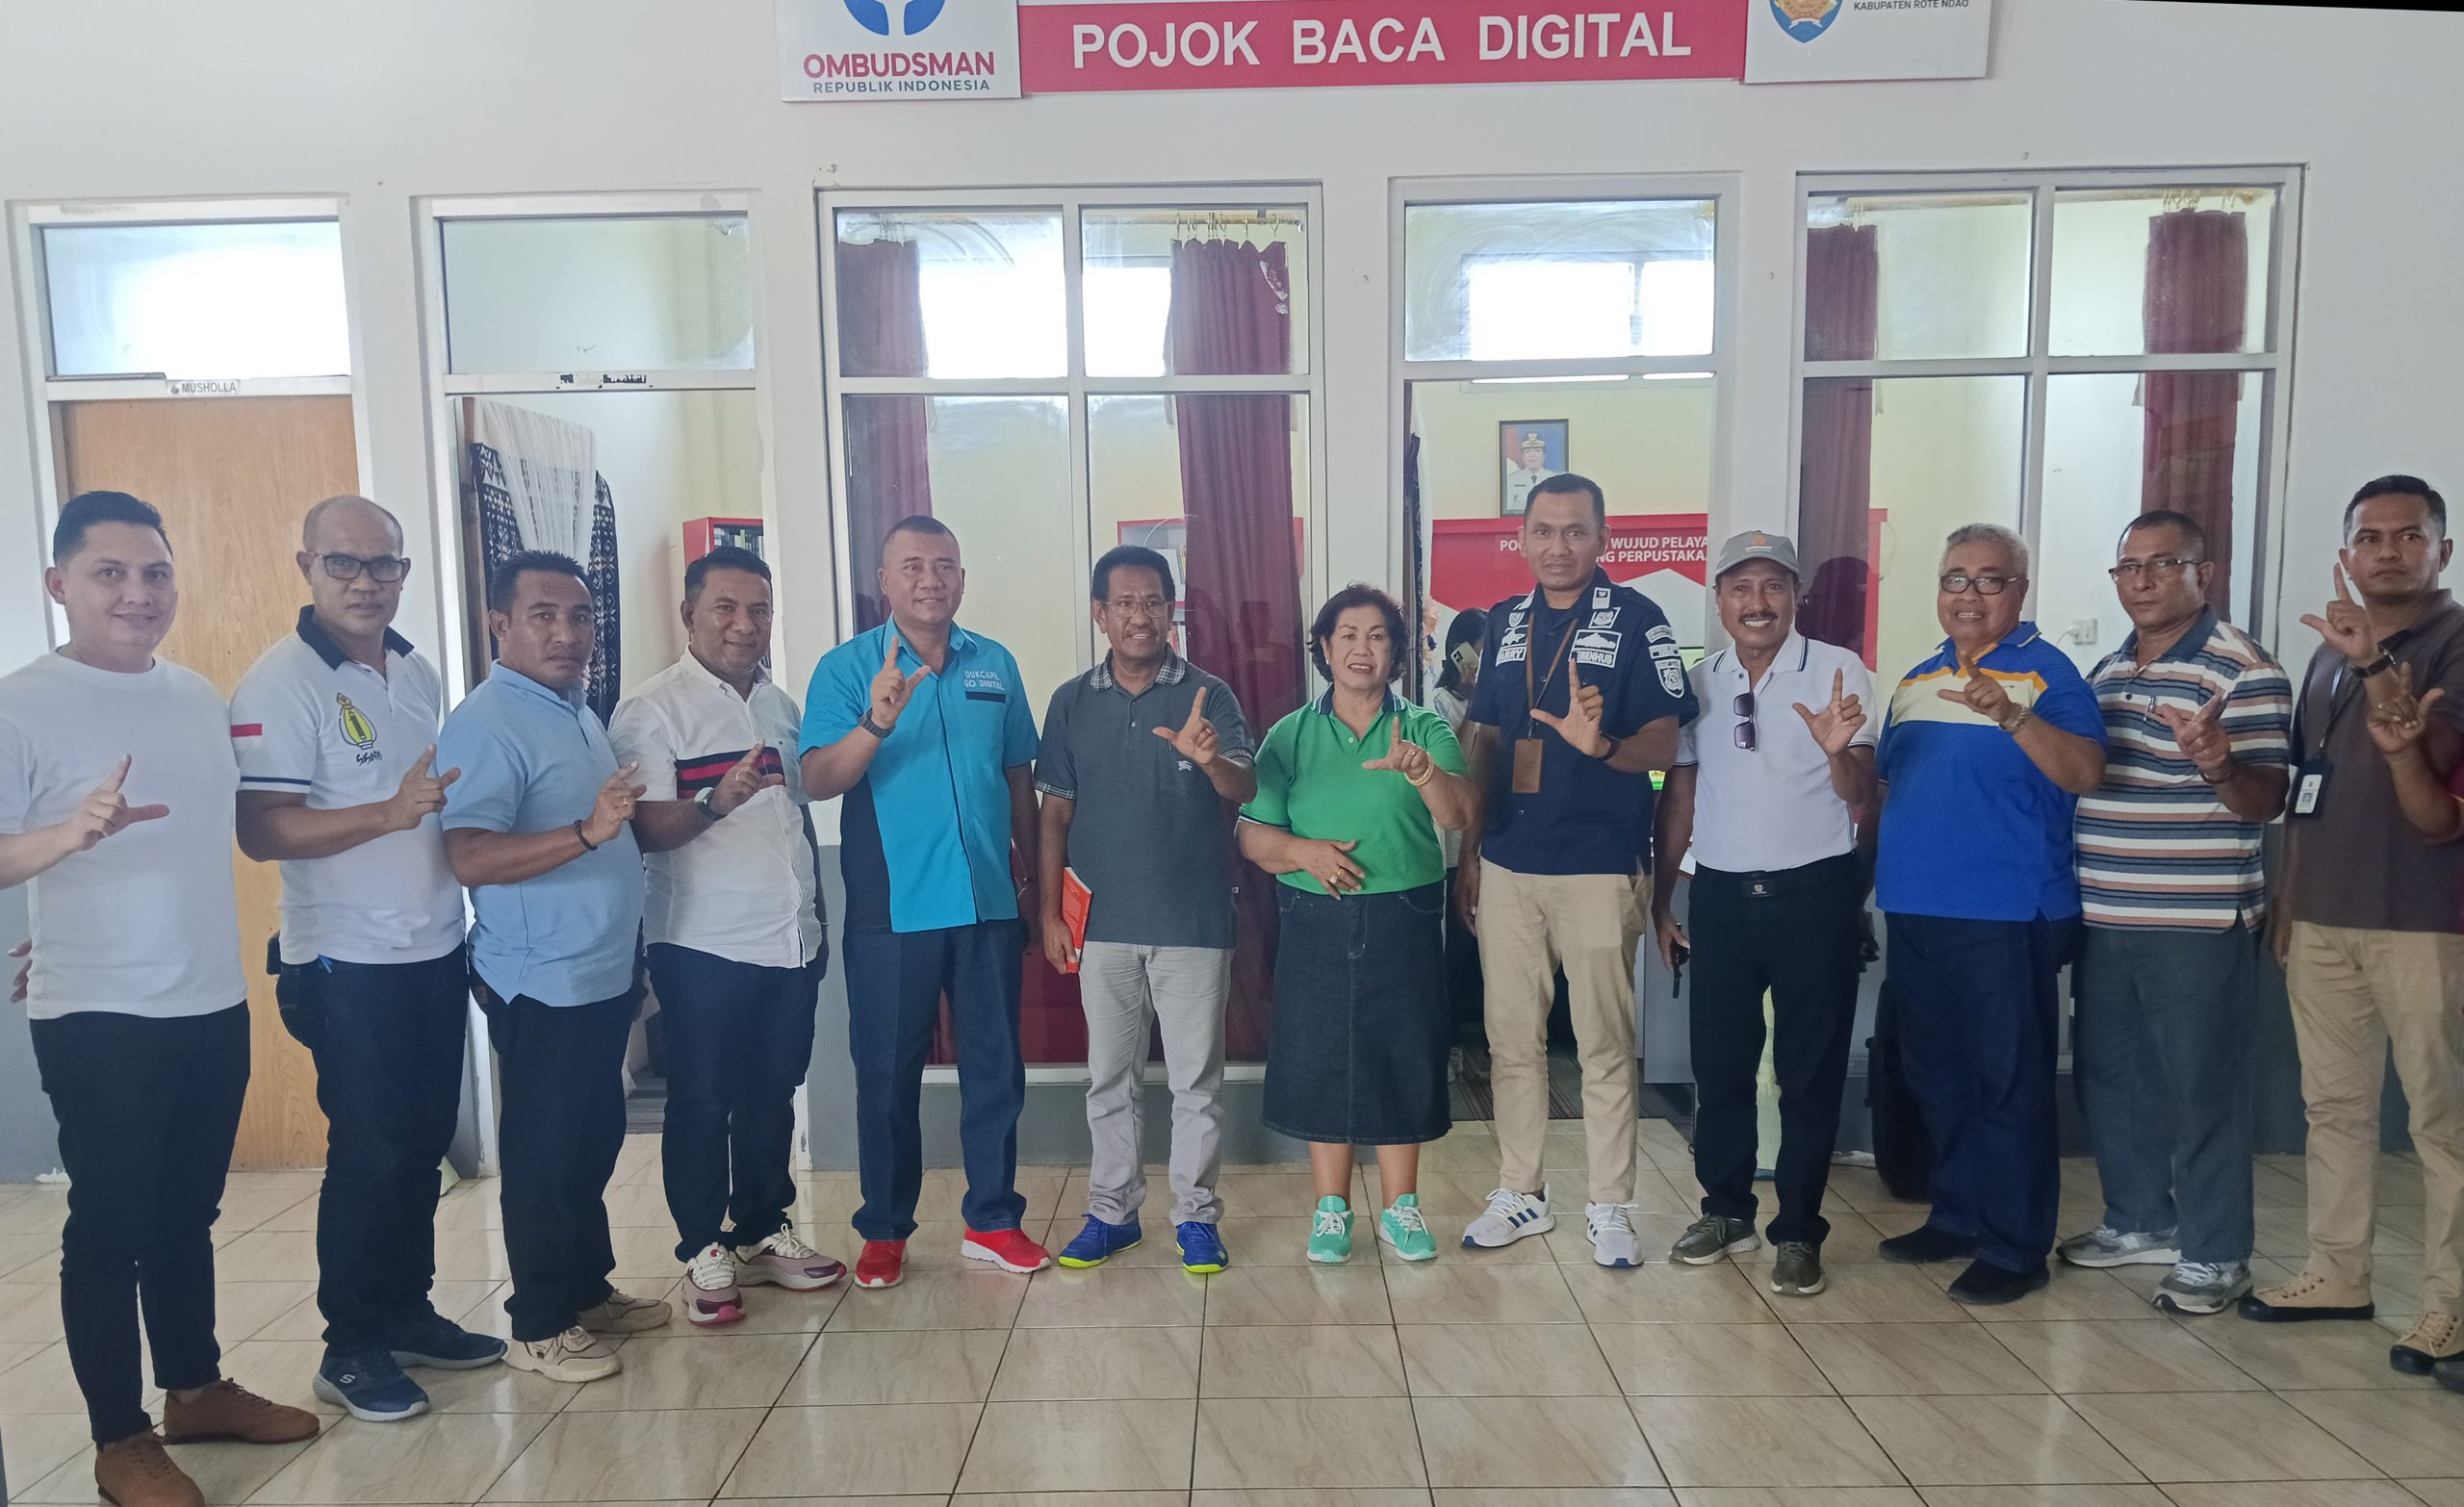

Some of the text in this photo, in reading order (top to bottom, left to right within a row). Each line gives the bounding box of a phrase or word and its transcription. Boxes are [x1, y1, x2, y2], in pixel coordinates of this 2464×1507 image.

[1854, 1, 1912, 11] KABUPATEN
[1913, 0, 1938, 9] ROTE
[1073, 13, 1691, 68] POJOK BACA DIGITAL
[804, 51, 995, 79] OMBUDSMAN
[813, 79, 990, 93] REPUBLIK INDONESIA
[182, 381, 237, 394] MUSHOLLA
[1500, 539, 1522, 551] PO
[1610, 537, 1659, 549] WUJUD
[1618, 549, 1707, 563] PERPUSTAKA
[964, 679, 976, 688] GO
